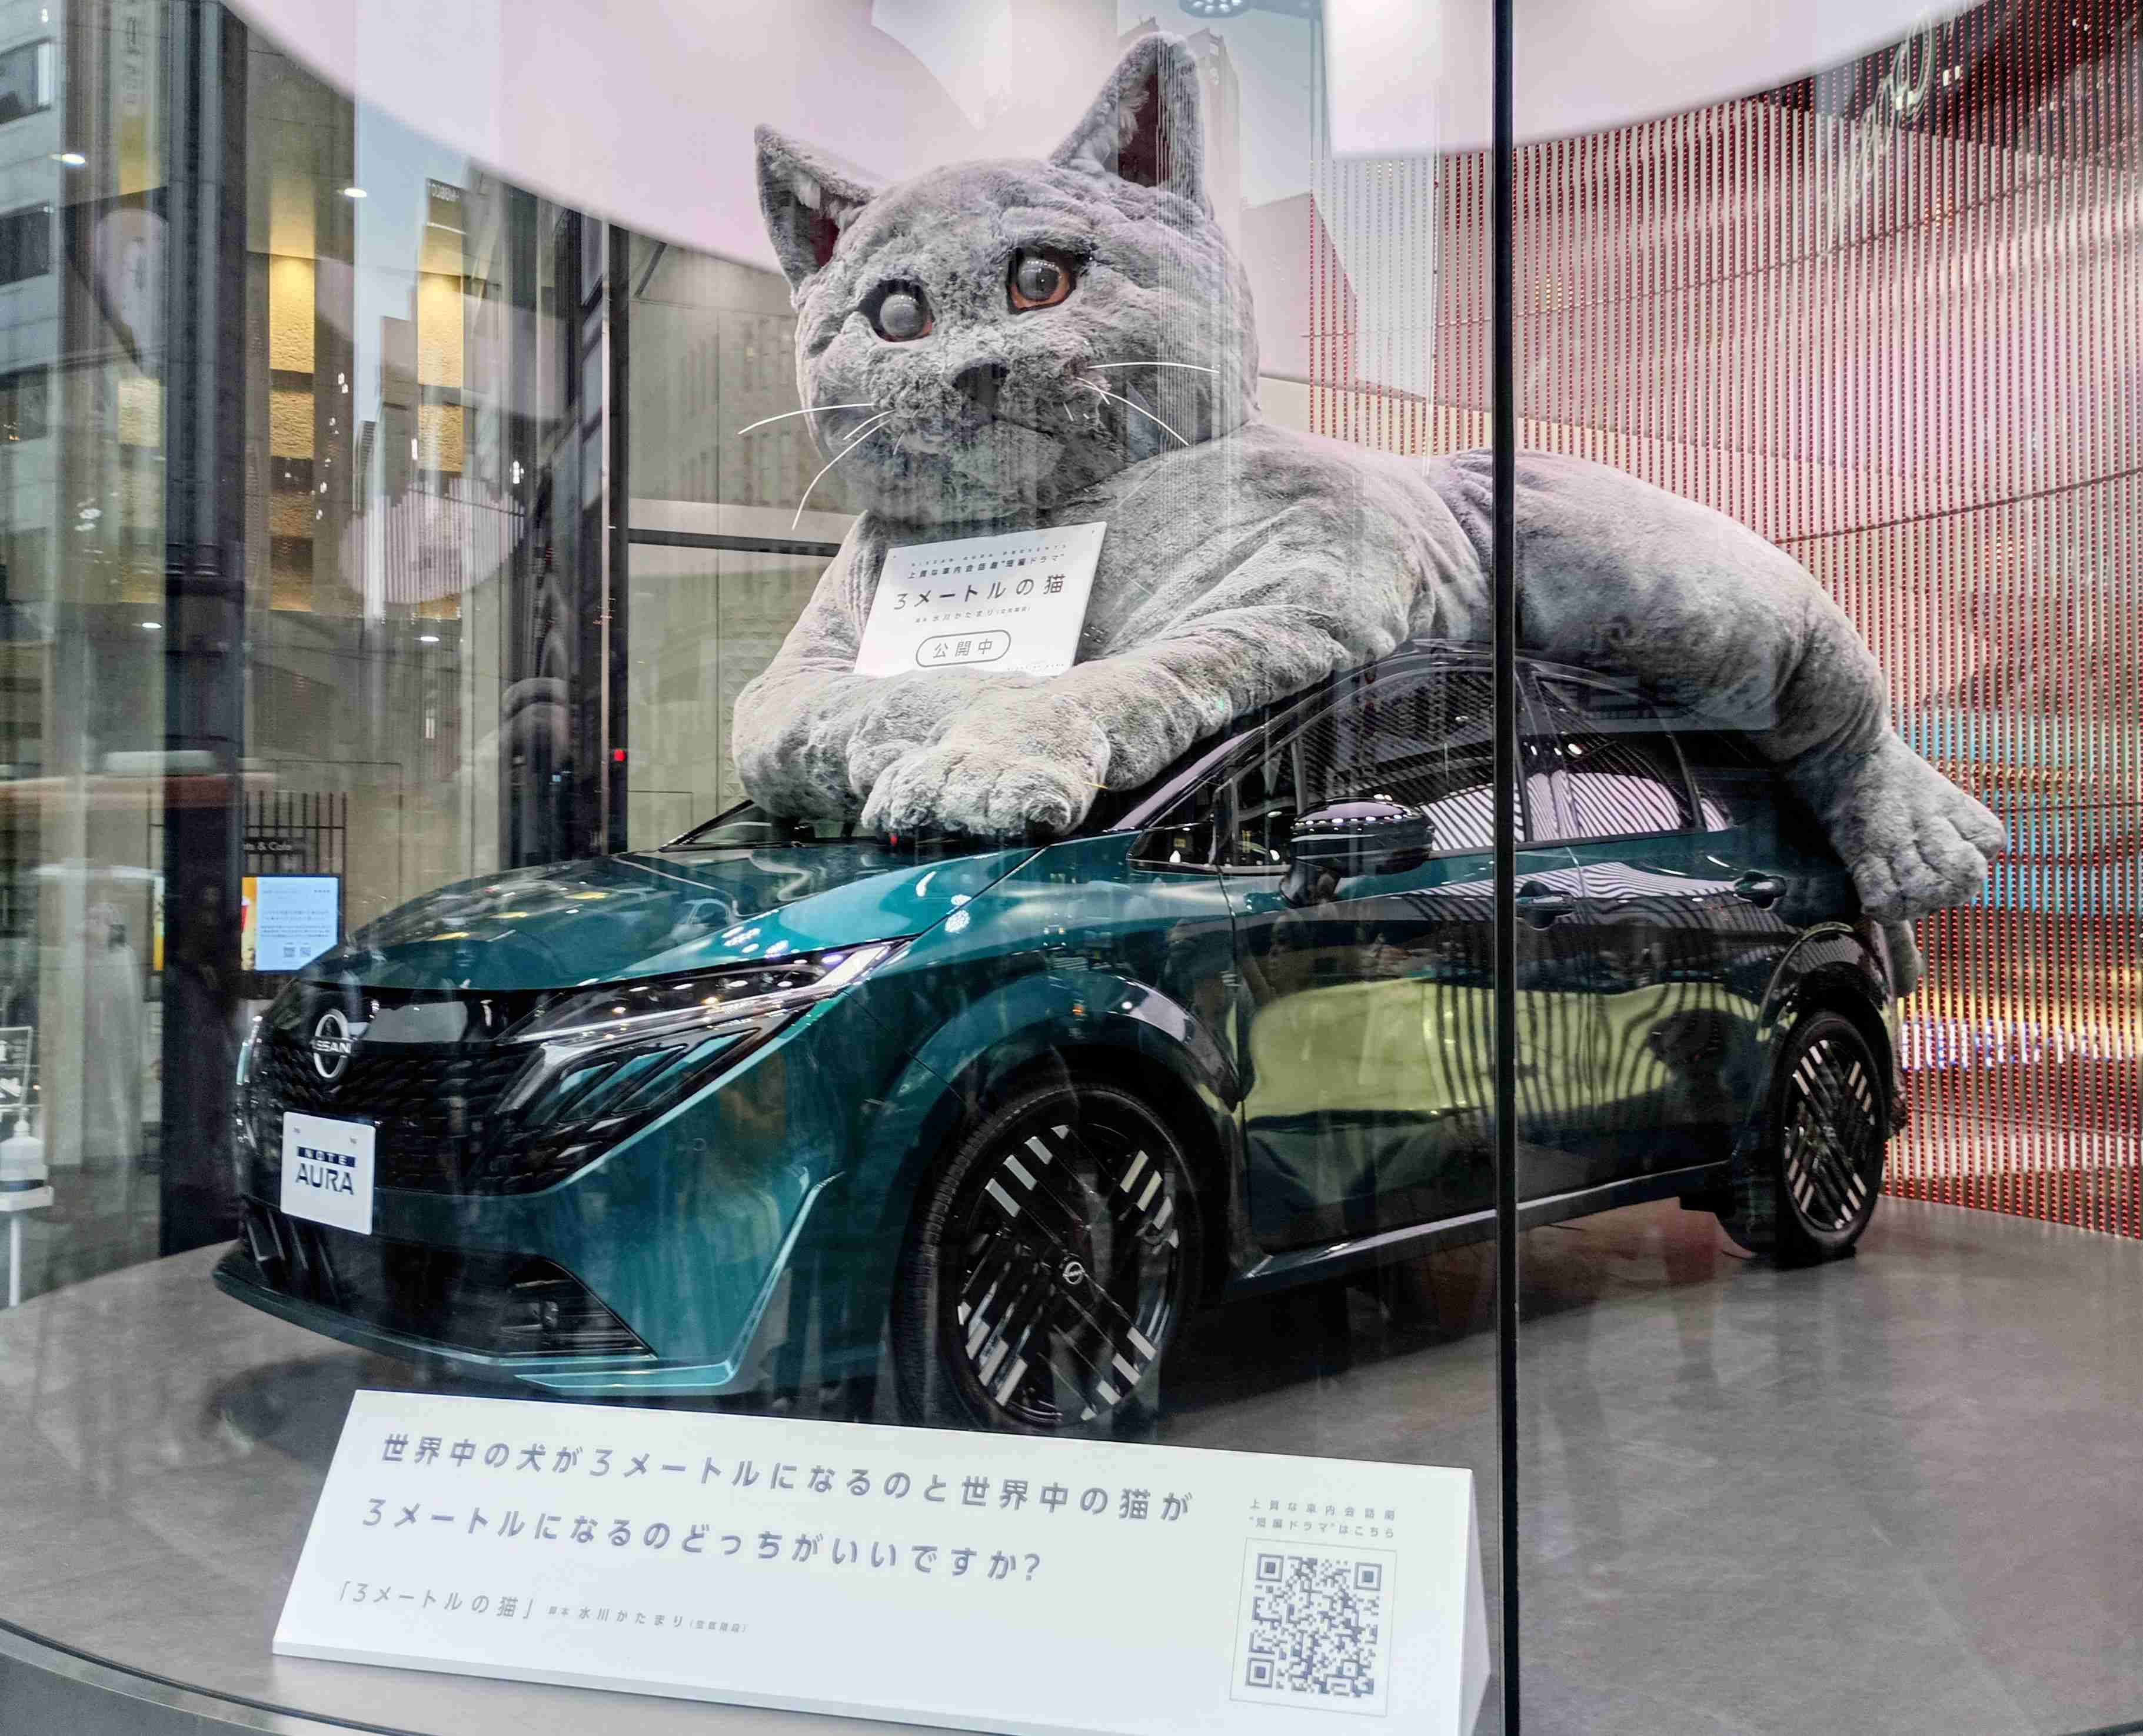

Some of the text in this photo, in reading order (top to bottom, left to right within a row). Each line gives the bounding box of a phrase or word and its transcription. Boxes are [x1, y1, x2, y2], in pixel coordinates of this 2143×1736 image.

[894, 574, 1066, 610] 3メートルの猫
[932, 638, 994, 659] 公開中
[304, 1148, 348, 1165] NOTE
[295, 1162, 355, 1196] AURA
[381, 1433, 1193, 1522] 世界中の犬が3メートルになるのと世界中の猫が
[362, 1497, 1041, 1582] 3メートルになるのどっちがいいですか?
